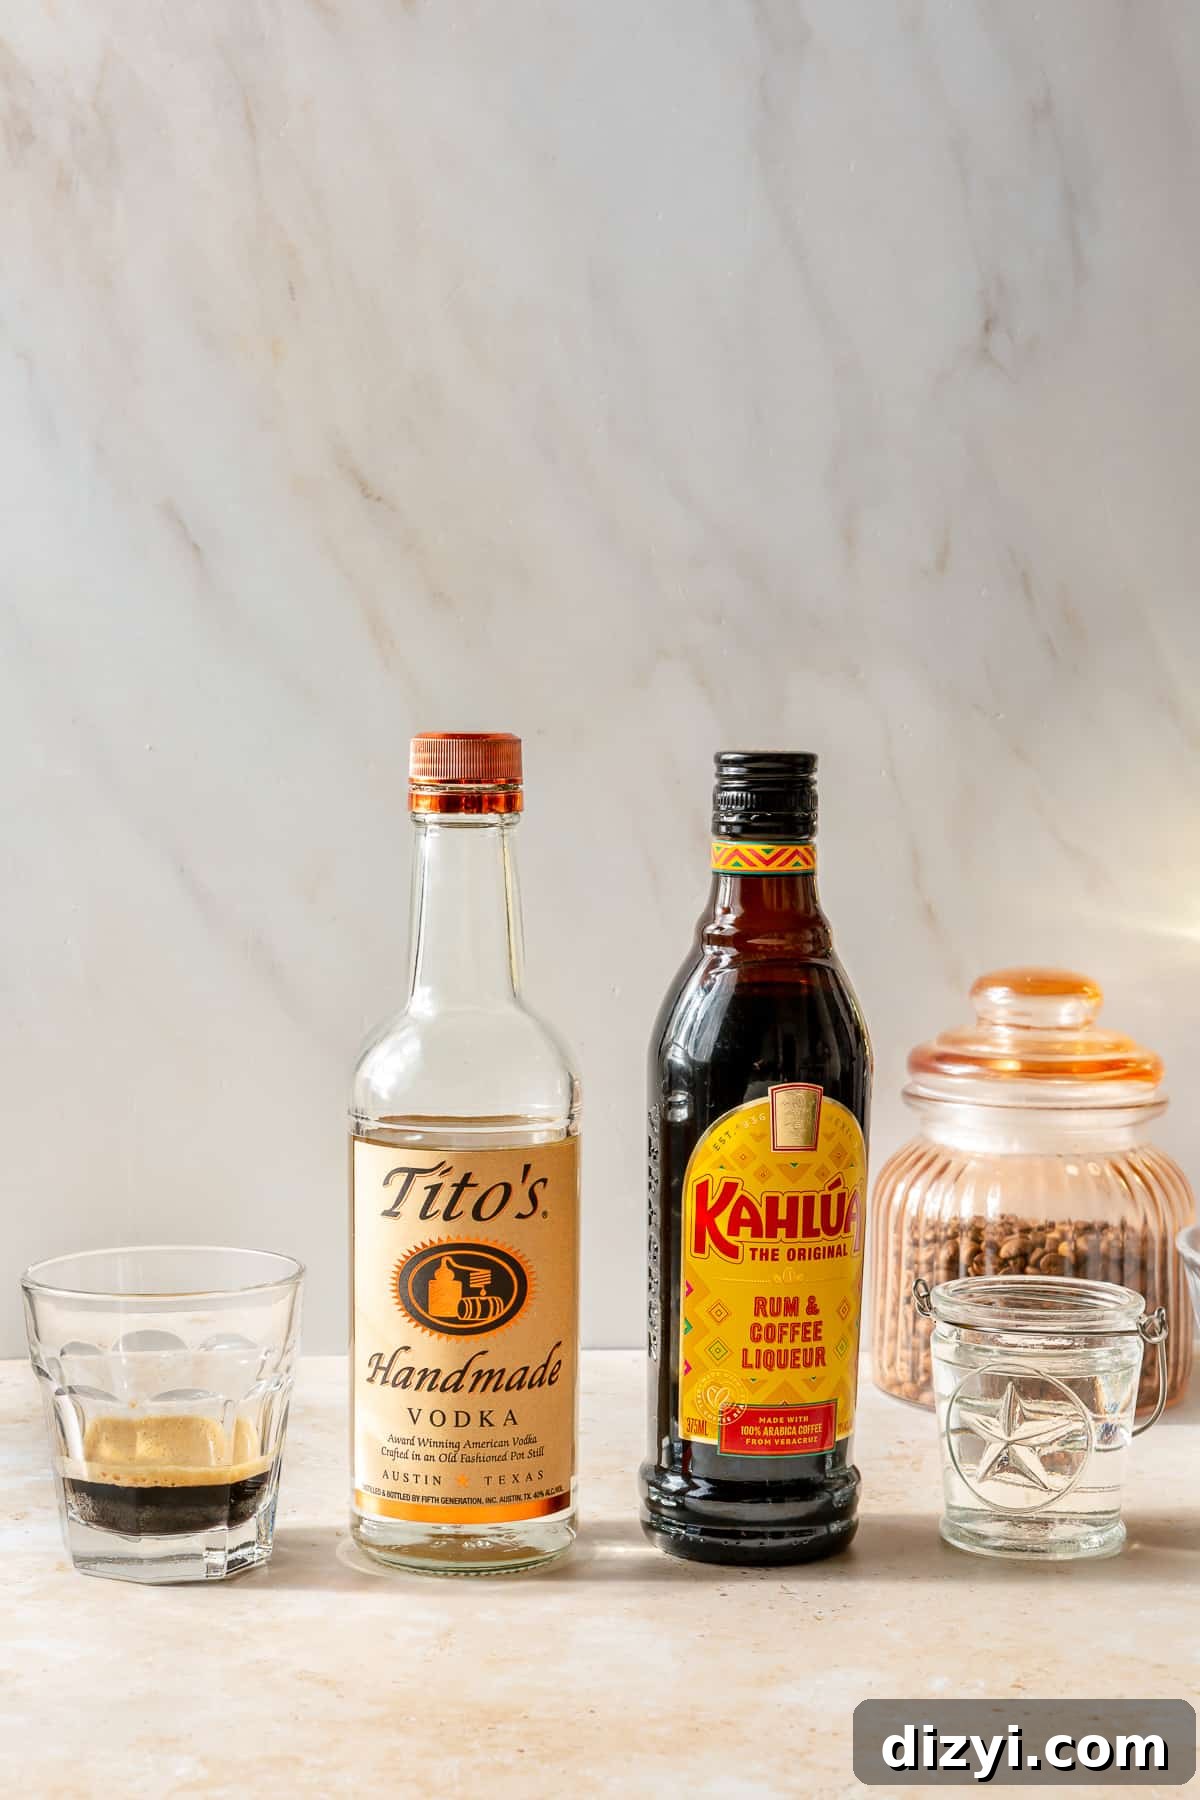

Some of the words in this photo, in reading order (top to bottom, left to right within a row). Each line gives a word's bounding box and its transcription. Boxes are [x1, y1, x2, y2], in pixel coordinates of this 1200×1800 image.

[381, 1160, 548, 1222] Tito's
[692, 1174, 862, 1264] KAHLÚA
[749, 1247, 779, 1262] THE
[786, 1243, 848, 1262] ORIGINAL
[753, 1296, 800, 1317] RUM
[805, 1295, 820, 1316] &
[749, 1320, 823, 1344] COFFEE
[366, 1341, 562, 1393] Handmade
[741, 1346, 827, 1372] LIQUEUR
[407, 1407, 519, 1427] VODKA
[686, 1417, 708, 1436] 375ML
[759, 1416, 785, 1424] MADE
[787, 1415, 809, 1423] WITH
[741, 1425, 761, 1436] 100%
[763, 1425, 797, 1436] ARABICA
[798, 1423, 822, 1435] COFFEE
[387, 1434, 416, 1446] Award
[417, 1438, 460, 1452] Winning
[463, 1439, 509, 1449] American
[512, 1433, 537, 1447] Vodka
[774, 1436, 817, 1445] VERACRUZ
[381, 1447, 410, 1461] Crafted
[412, 1451, 421, 1461] in
[424, 1454, 435, 1462] an
[438, 1452, 457, 1463] Old
[460, 1450, 508, 1463] Fashioned
[510, 1451, 525, 1461] Pot
[527, 1446, 544, 1459] Still
[382, 1469, 441, 1485] AUSTIN
[483, 1469, 544, 1486] TEXAS
[387, 1490, 410, 1501] BOTTLED
[411, 1494, 420, 1502] BY
[421, 1496, 439, 1504] FIFTH
